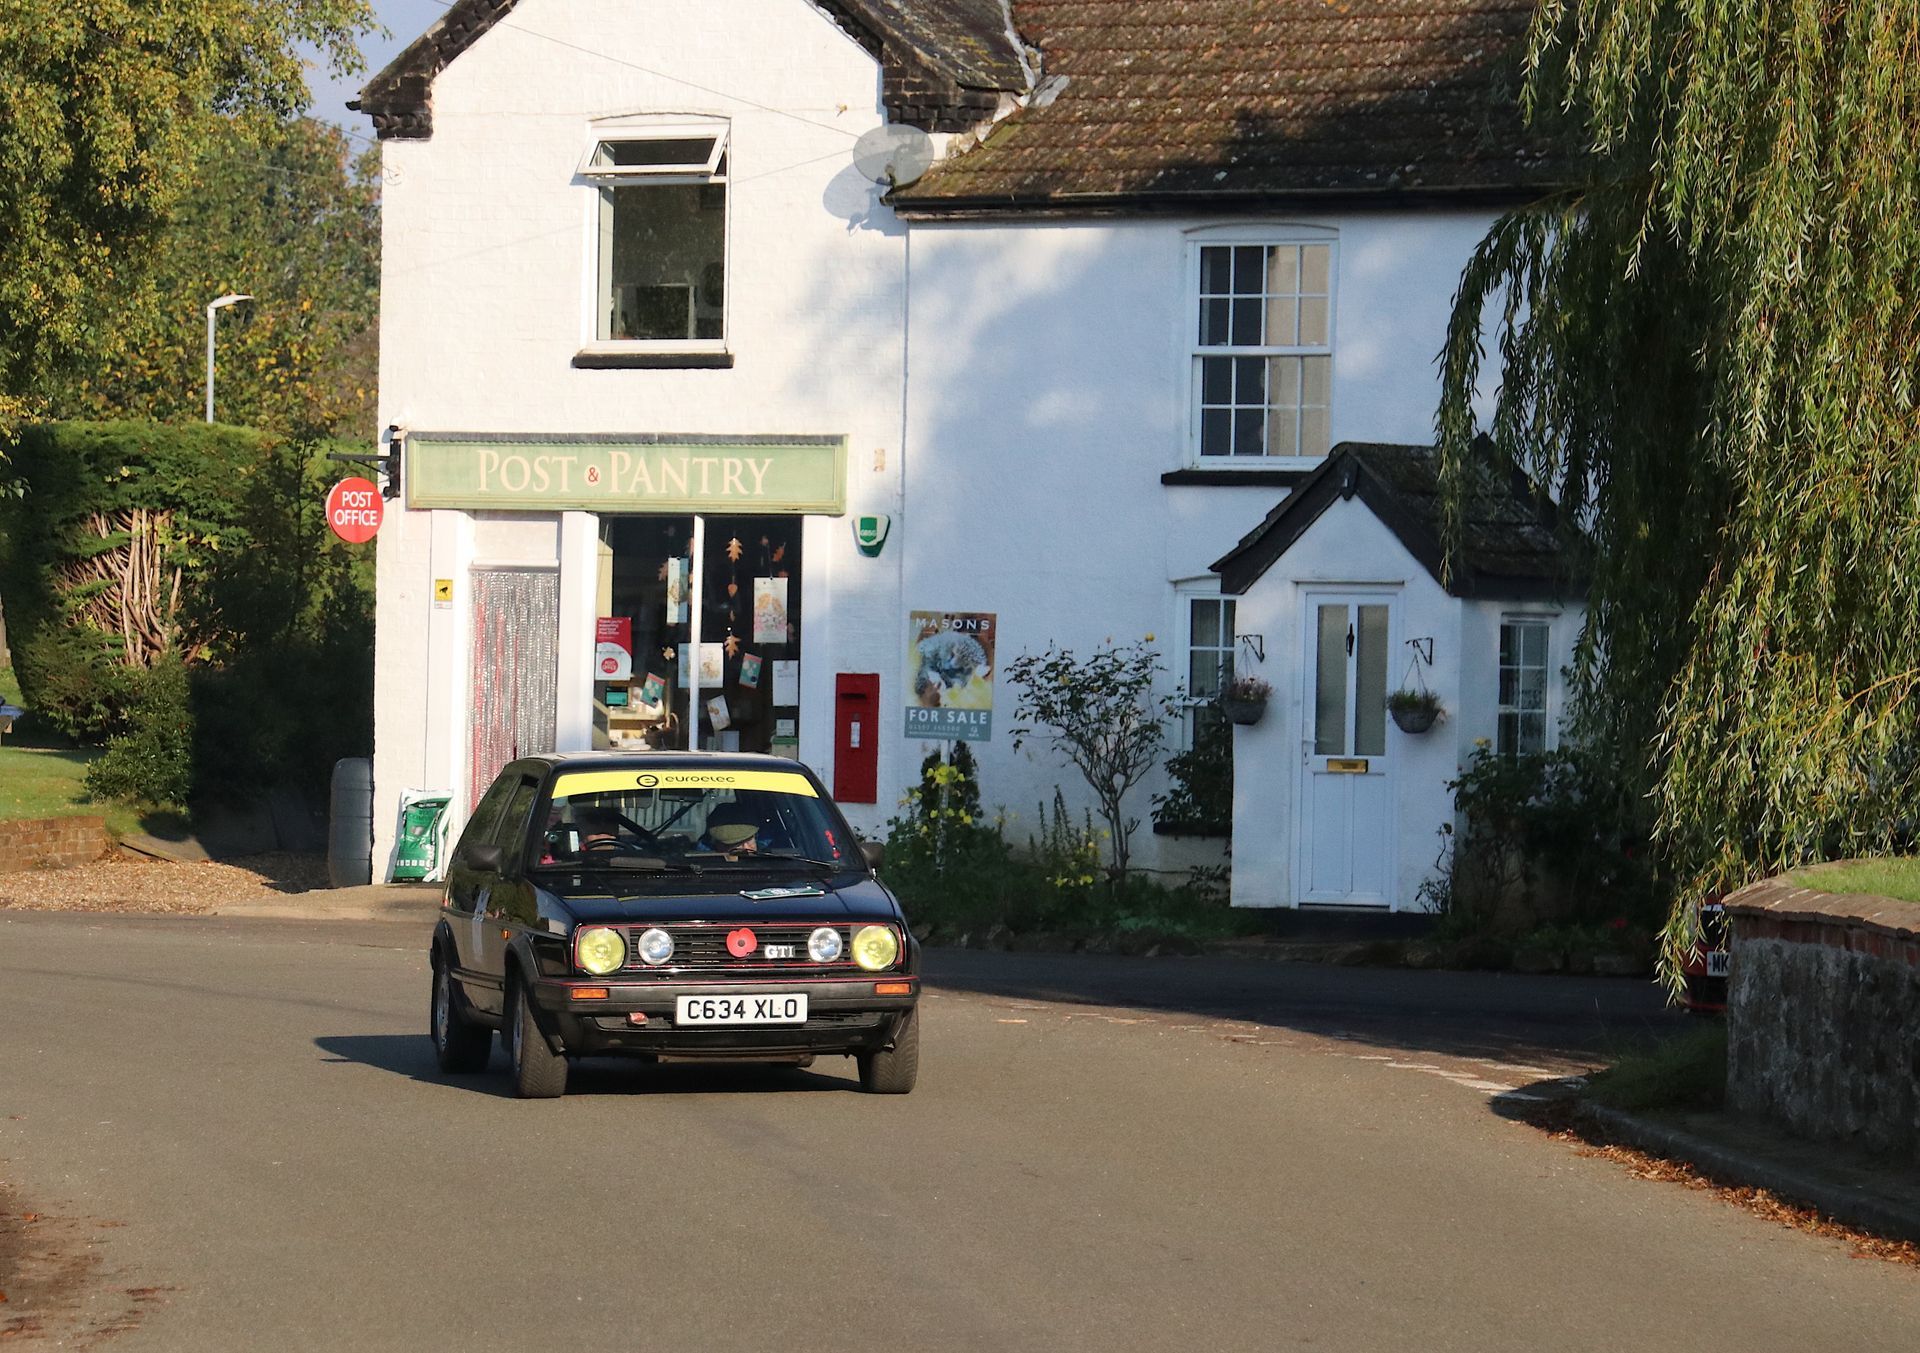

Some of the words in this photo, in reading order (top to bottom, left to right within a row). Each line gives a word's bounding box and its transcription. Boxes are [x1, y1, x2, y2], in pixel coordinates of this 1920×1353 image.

[476, 449, 578, 494] POST
[587, 466, 599, 484] &
[608, 450, 773, 495] PANTRY
[342, 491, 373, 507] POST
[334, 509, 378, 526] OFFICE
[915, 617, 990, 630] MASONS
[909, 709, 939, 723] FOR
[947, 711, 988, 725] SALE
[765, 945, 794, 959] GTI
[687, 999, 747, 1020] C634
[754, 998, 798, 1019] XLO
